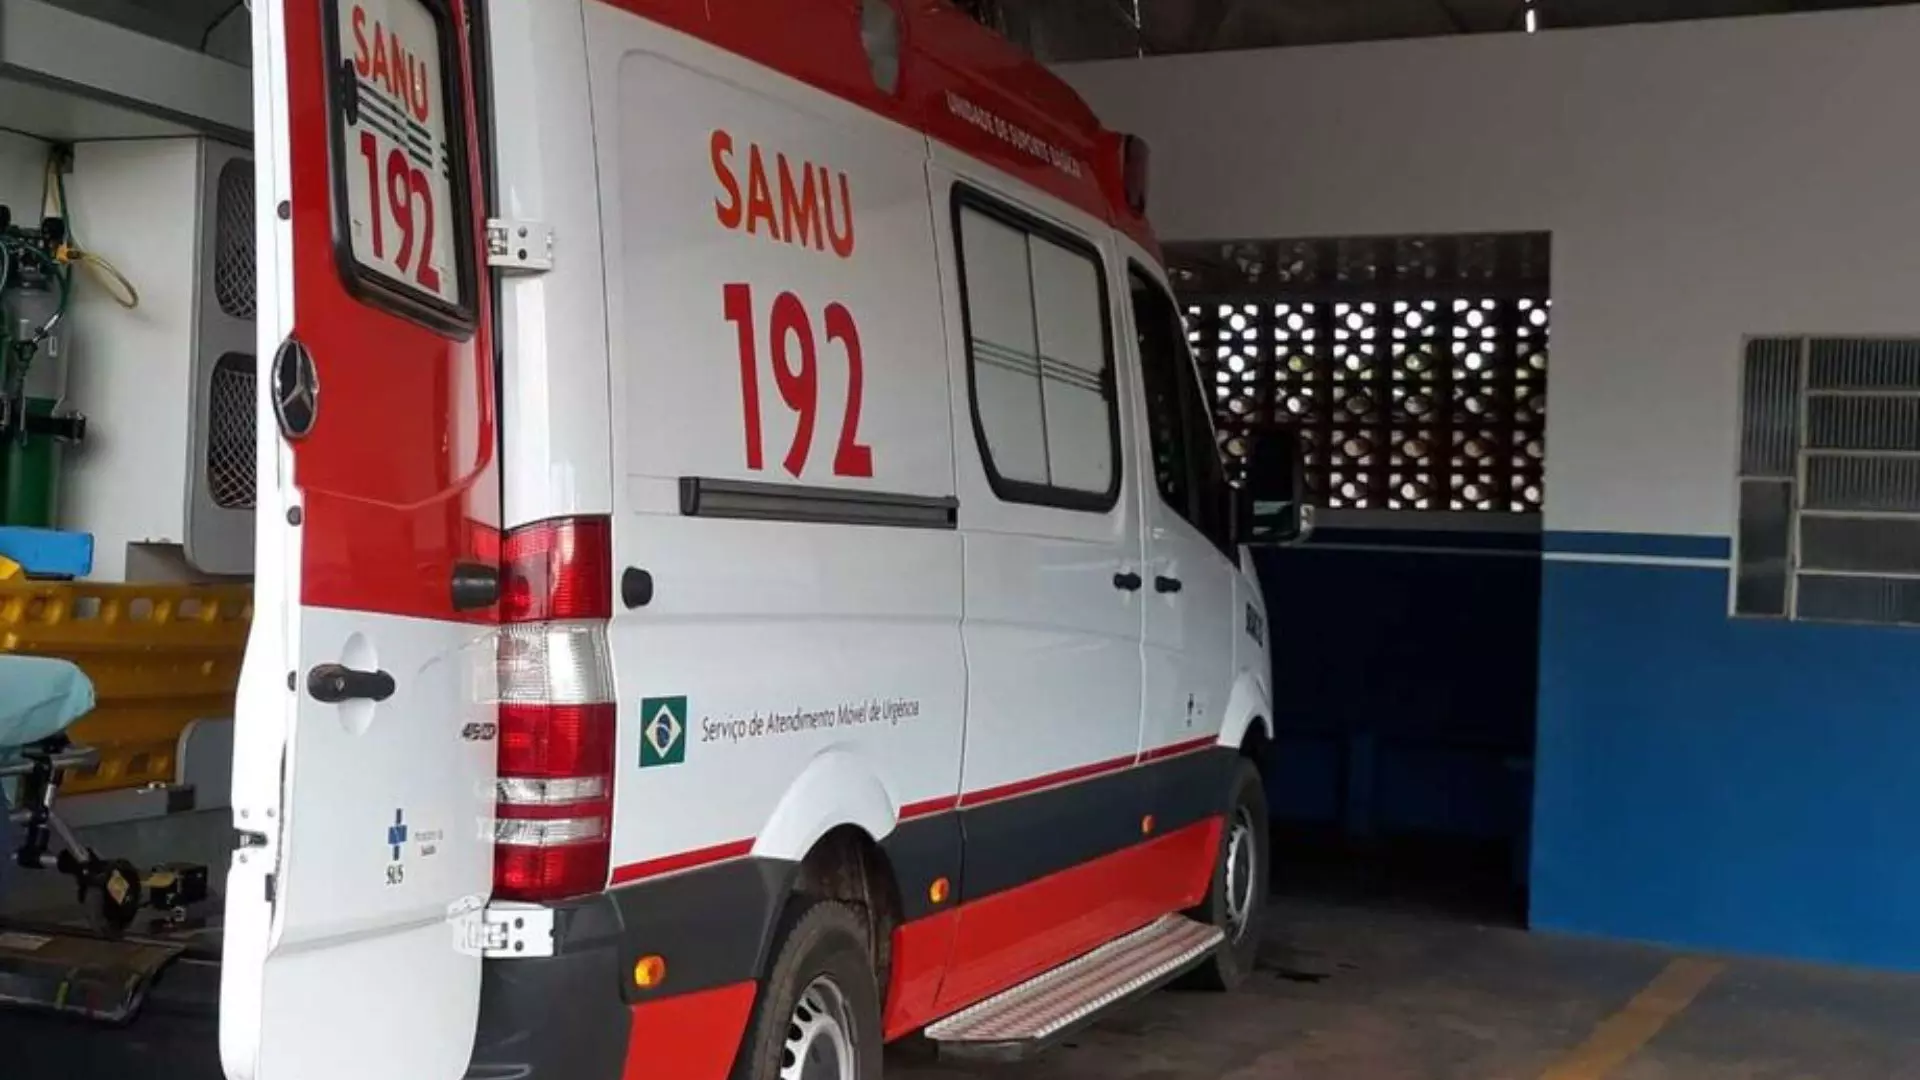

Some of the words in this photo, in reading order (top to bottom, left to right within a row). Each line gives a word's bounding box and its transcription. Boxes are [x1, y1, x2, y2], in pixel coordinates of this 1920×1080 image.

[352, 5, 428, 123] SAMU
[360, 129, 440, 294] 192
[710, 130, 855, 258] SAMU
[723, 282, 873, 478] 192
[701, 714, 746, 744] Serviço
[748, 710, 764, 736] de
[766, 705, 834, 734] Atendimento
